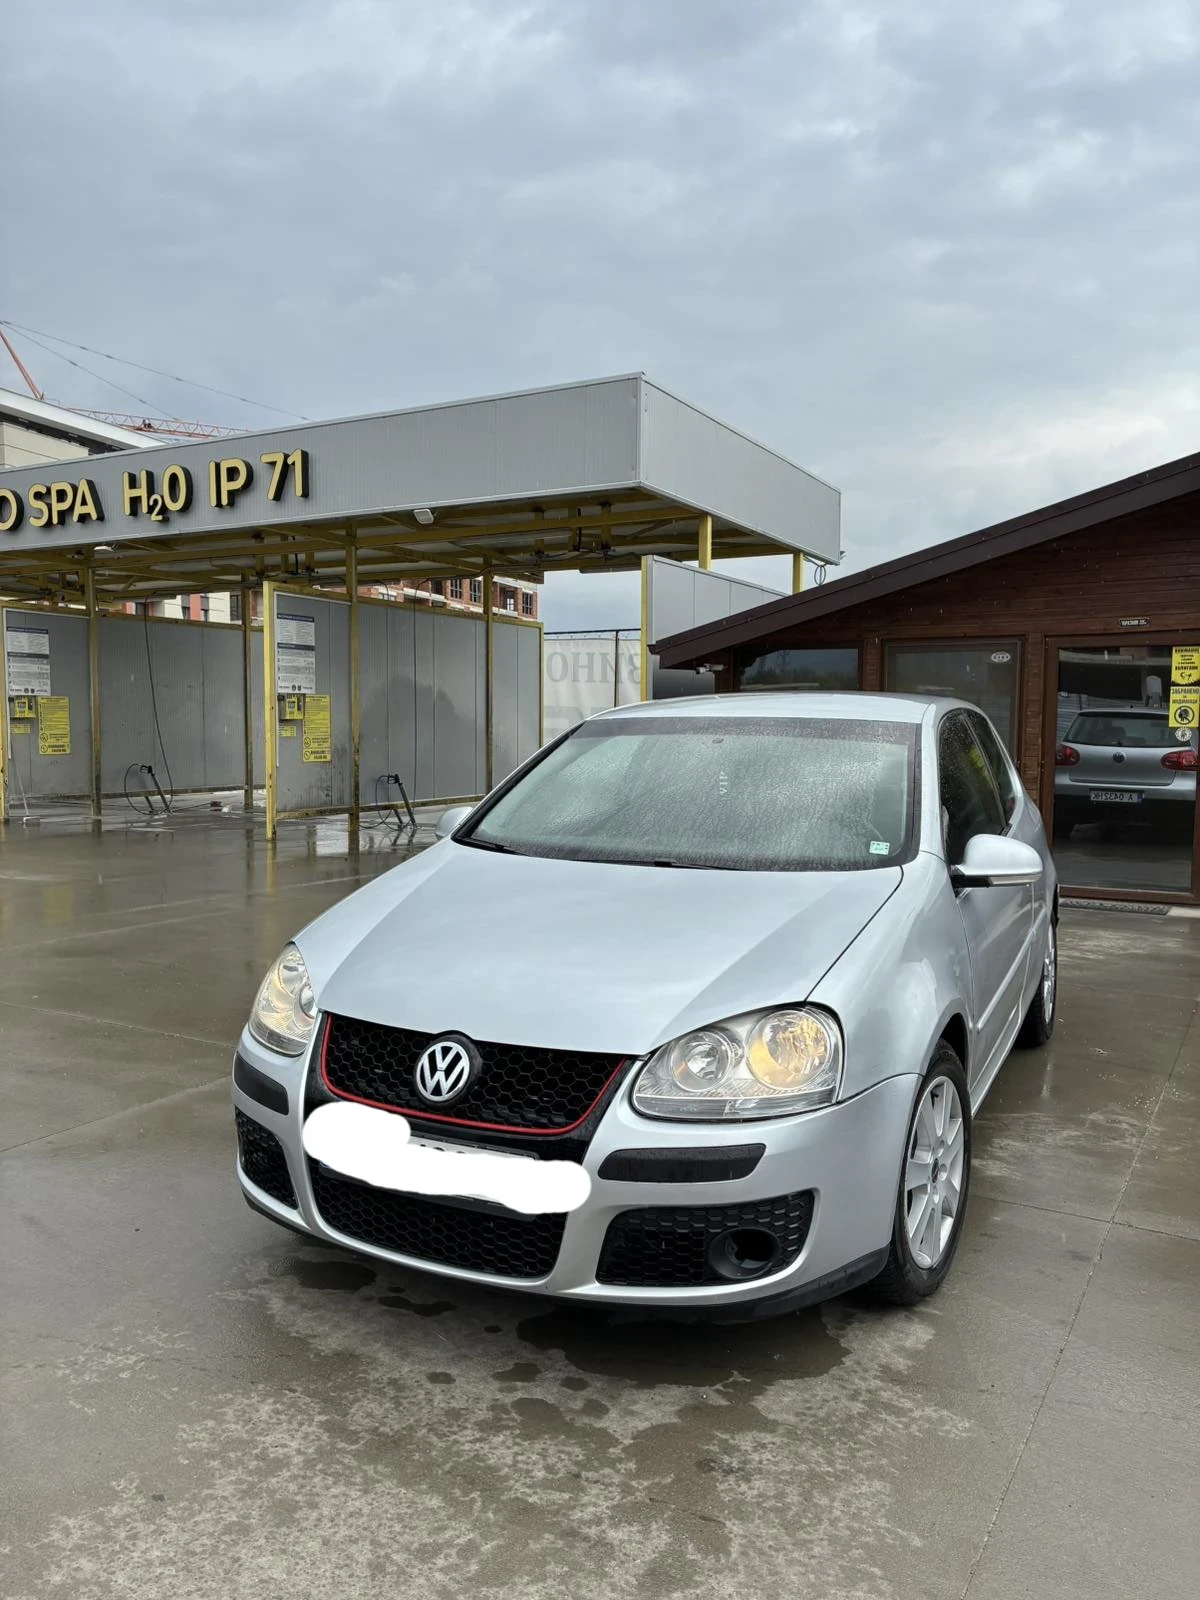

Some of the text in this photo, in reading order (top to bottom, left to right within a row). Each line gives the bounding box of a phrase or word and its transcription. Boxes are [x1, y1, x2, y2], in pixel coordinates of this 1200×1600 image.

[28, 478, 101, 528] SPA
[208, 458, 250, 507] IP
[260, 448, 306, 501] 71
